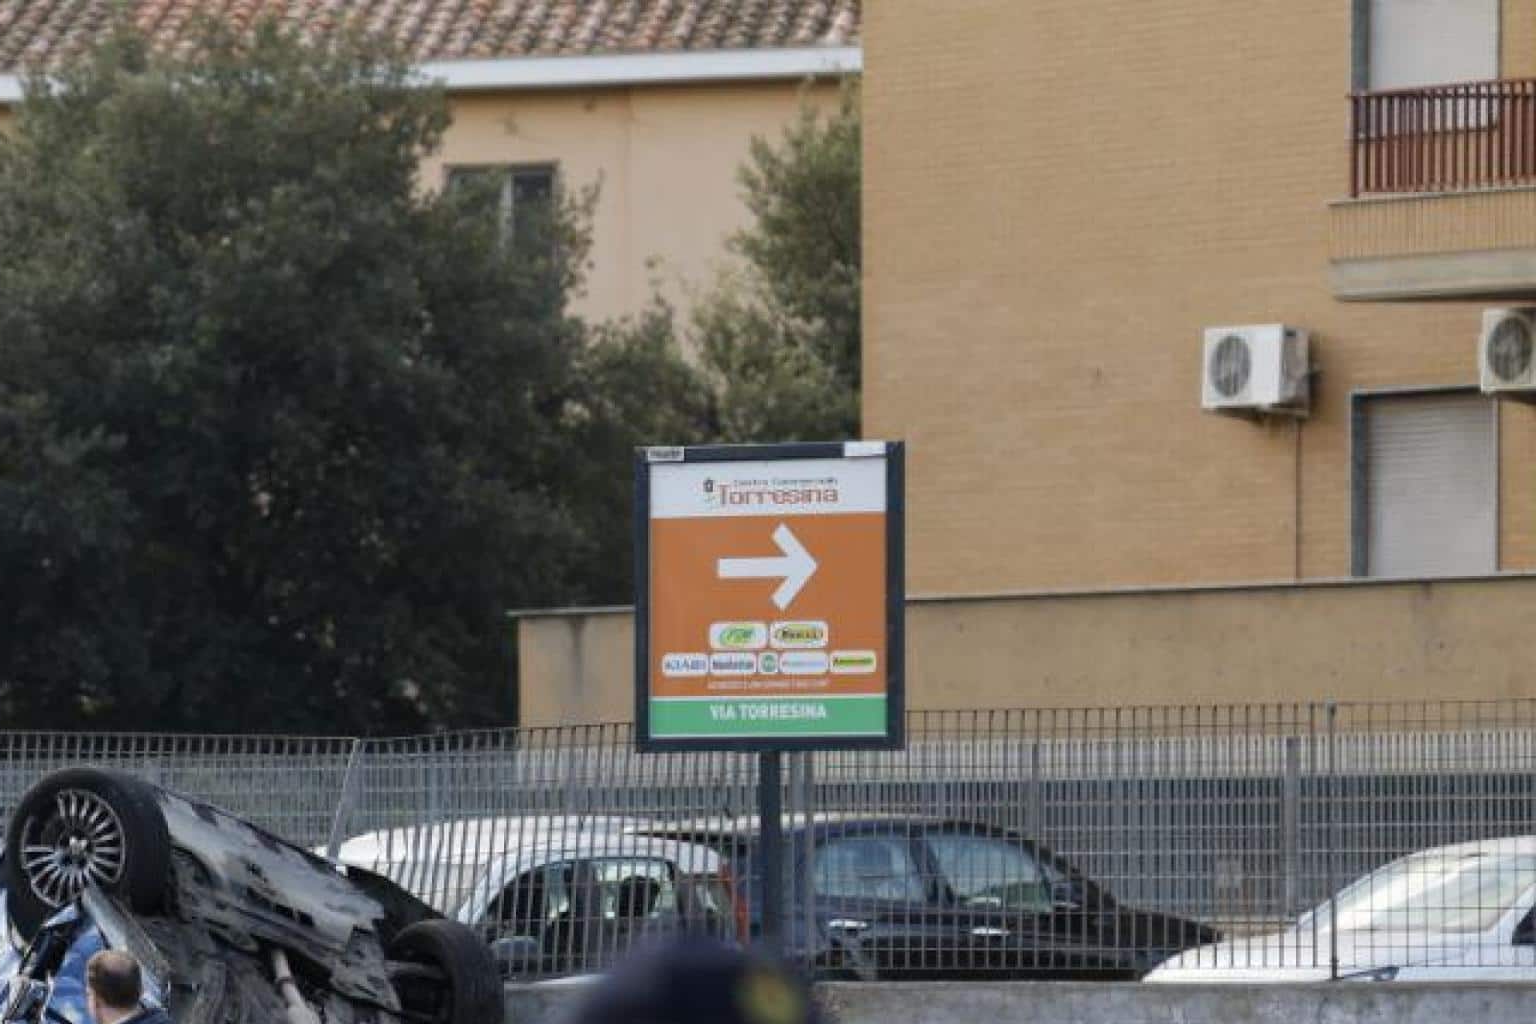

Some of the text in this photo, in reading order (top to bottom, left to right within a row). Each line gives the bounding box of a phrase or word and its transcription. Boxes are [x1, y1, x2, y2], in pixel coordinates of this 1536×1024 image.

[718, 484, 839, 506] Torresina
[709, 703, 826, 720] VIA TORRESINA
